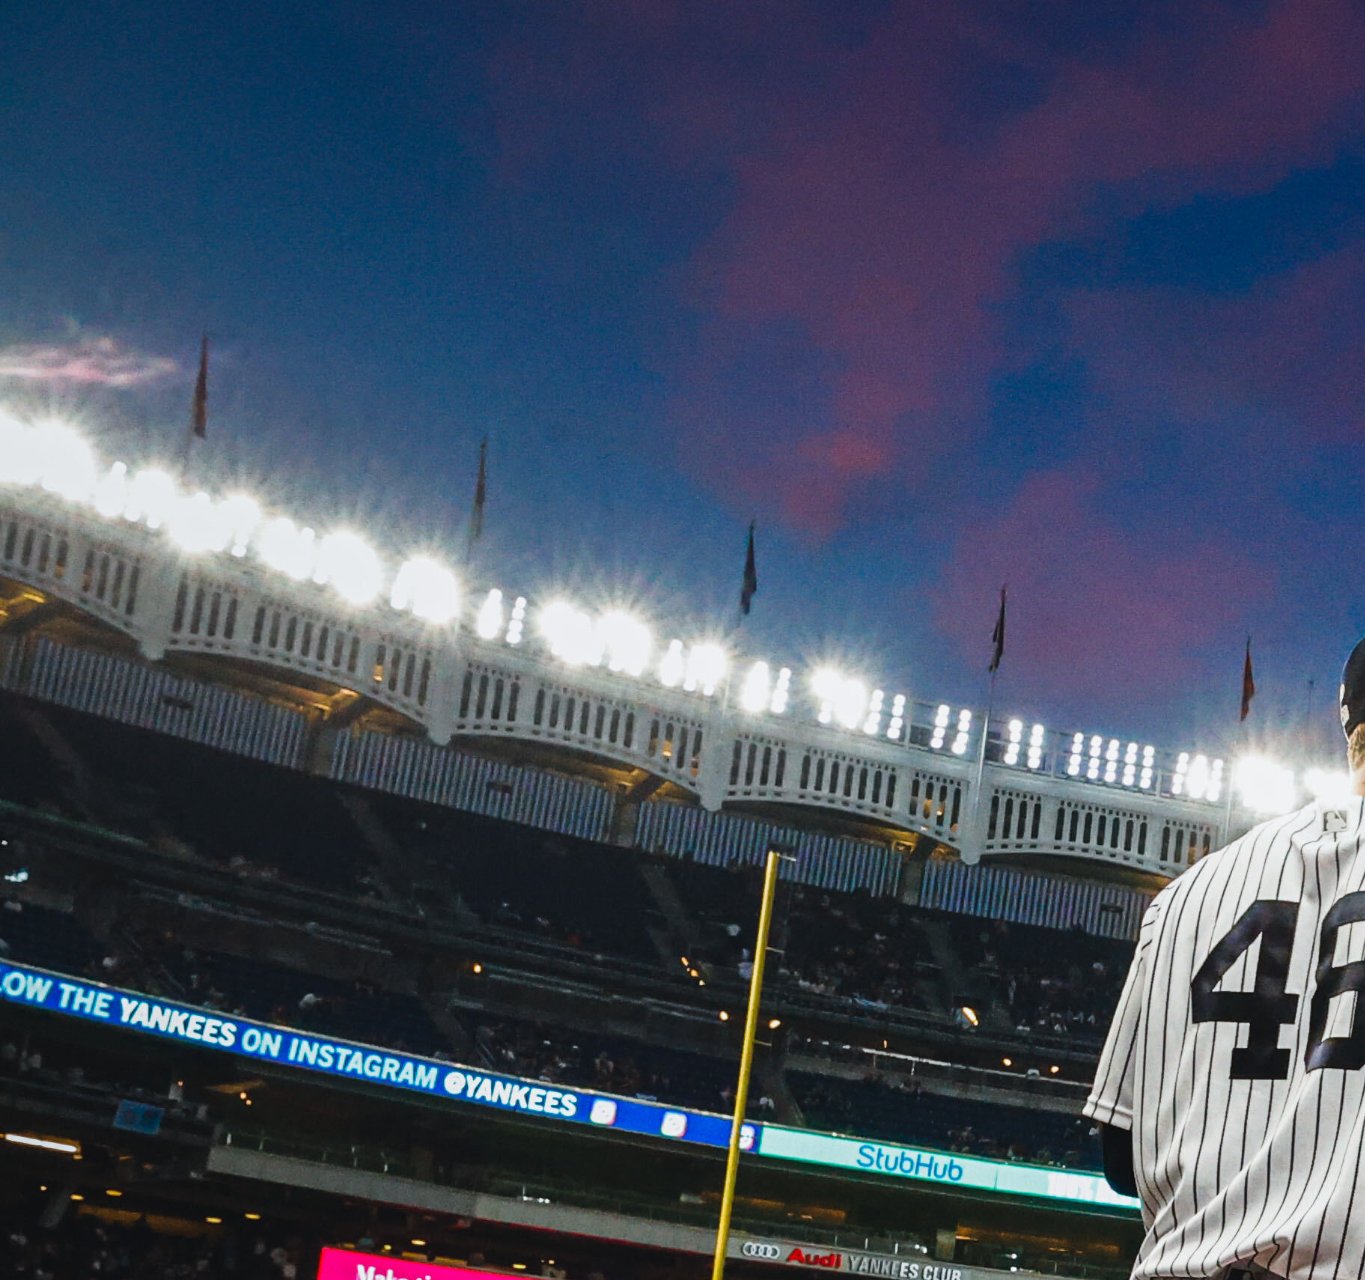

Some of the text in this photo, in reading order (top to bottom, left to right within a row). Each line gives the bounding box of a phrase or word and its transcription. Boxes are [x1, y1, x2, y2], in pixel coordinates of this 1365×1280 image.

[0, 971, 578, 1116] OW THE YANKEES ON INSTAGRAM @YANKEES
[856, 1145, 963, 1181] StubHub
[786, 1248, 841, 1268] Audi
[850, 1255, 919, 1279] YANKEES
